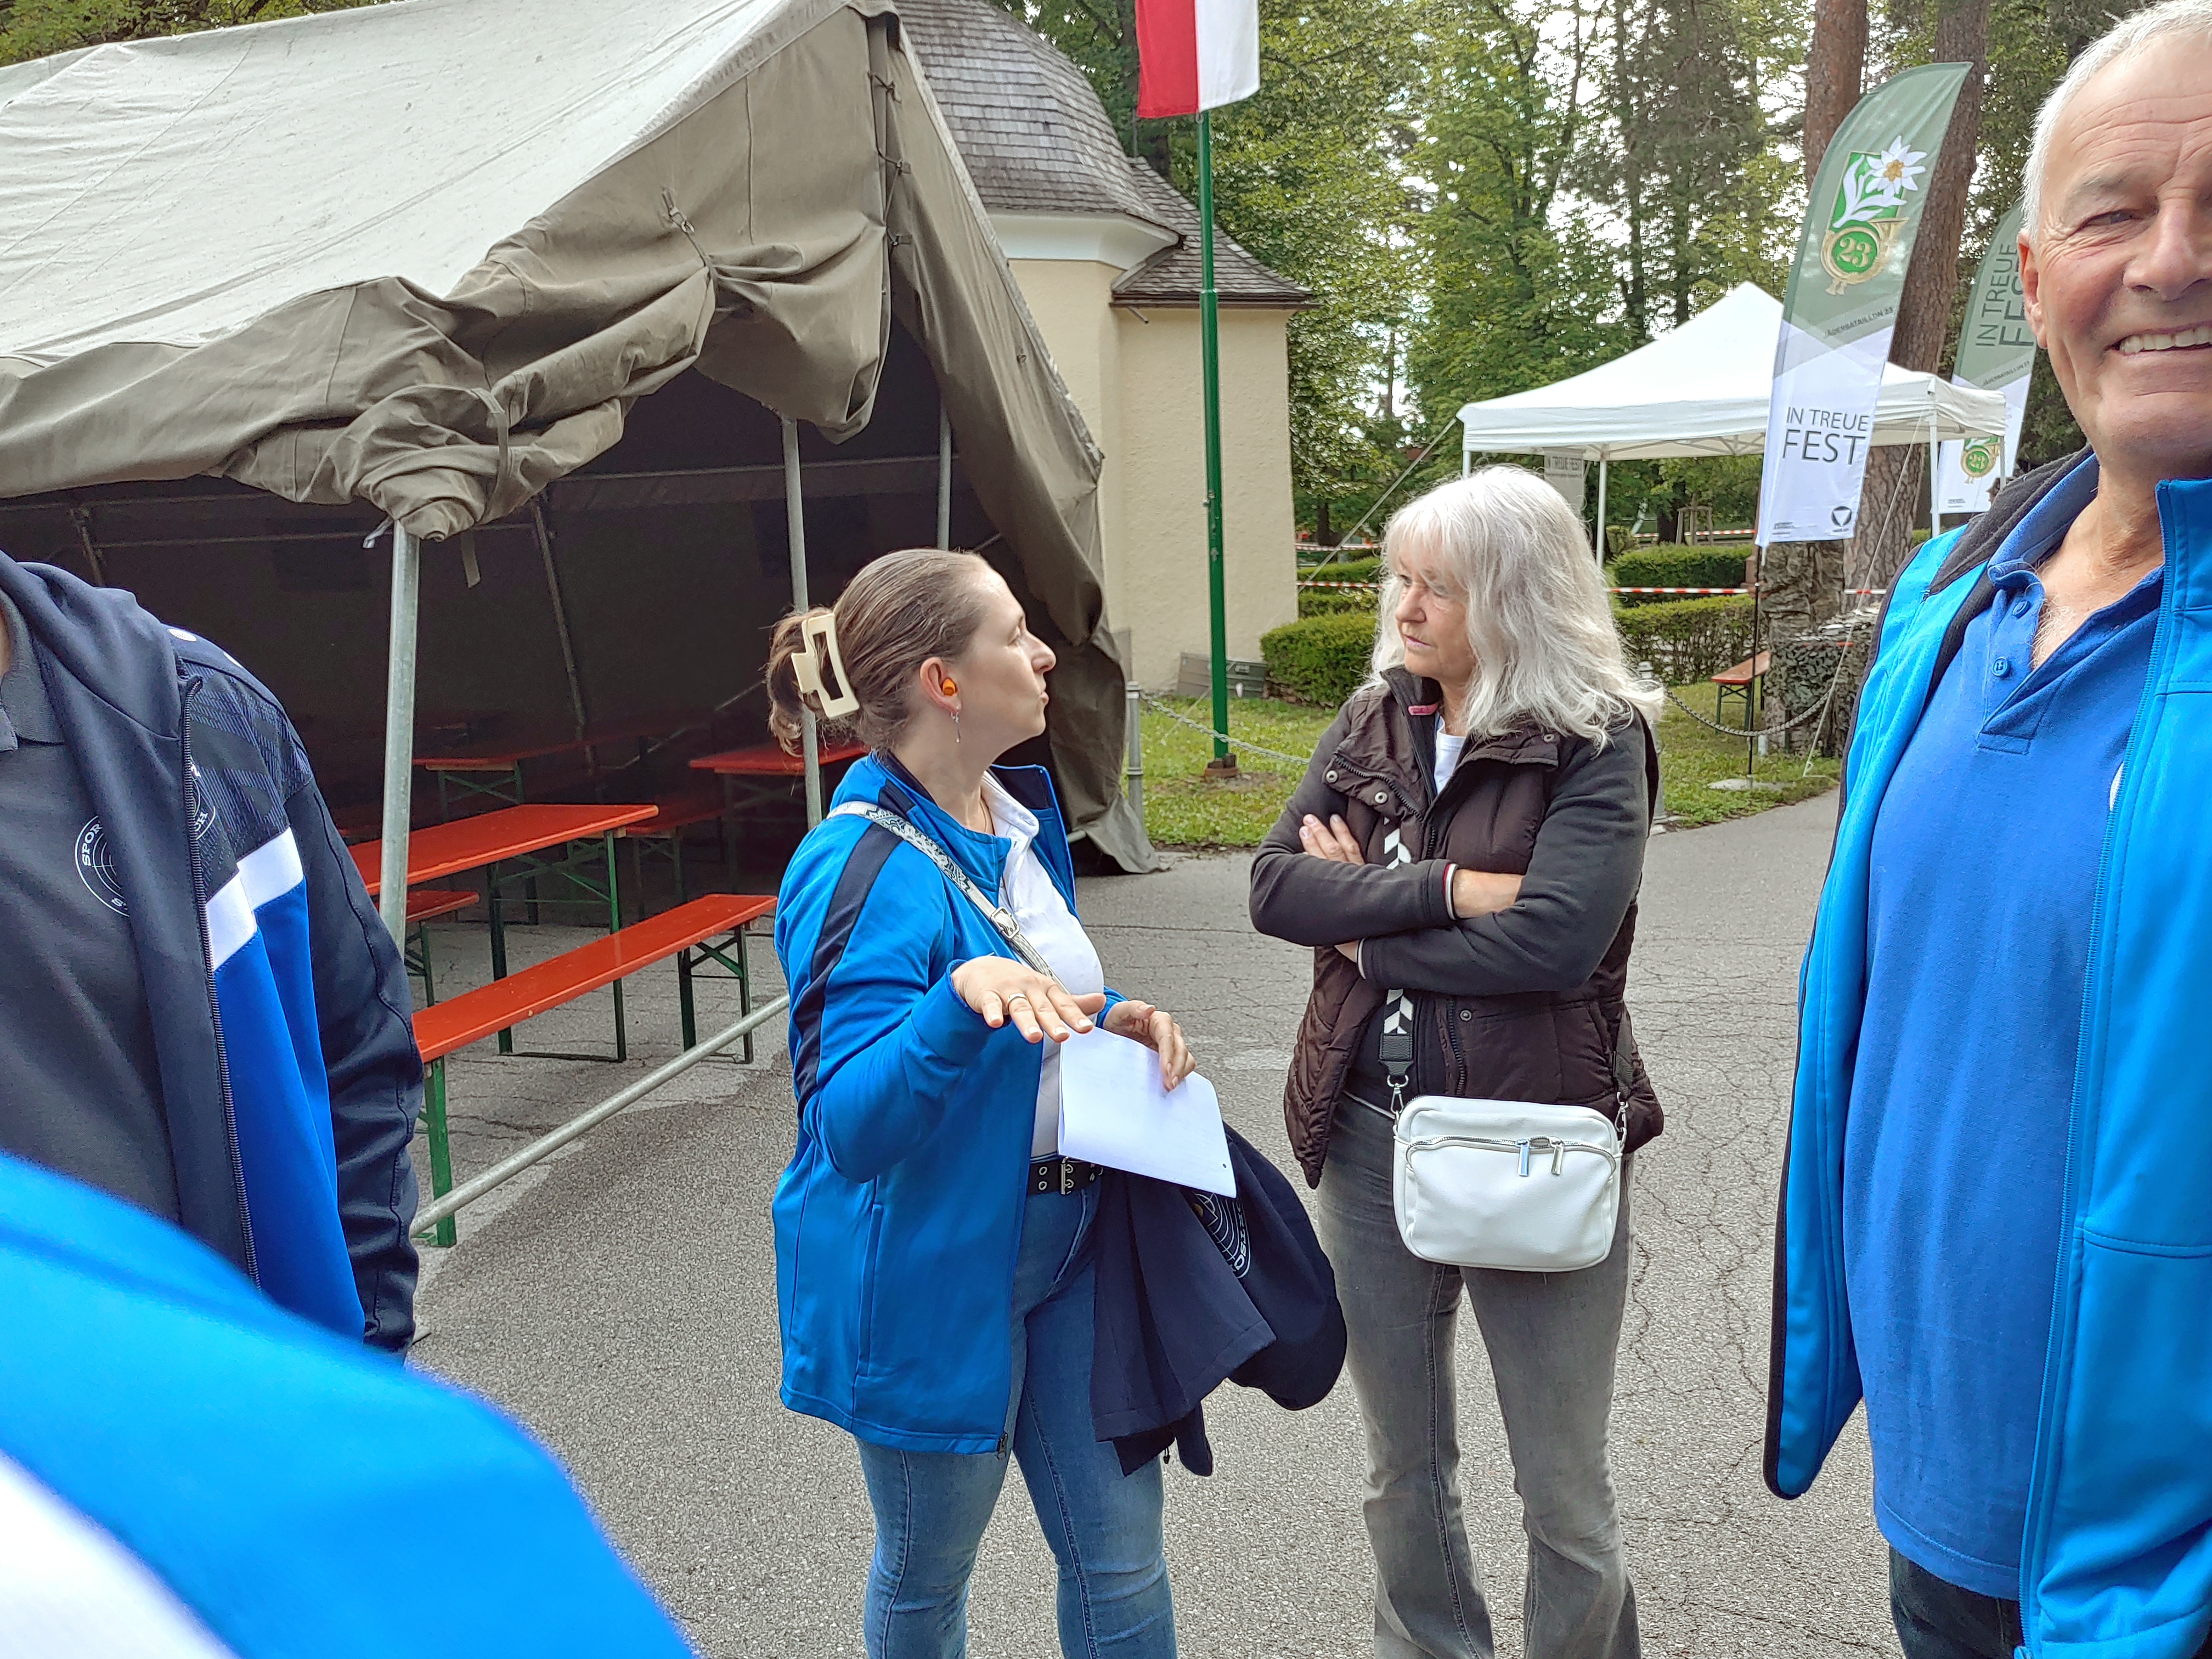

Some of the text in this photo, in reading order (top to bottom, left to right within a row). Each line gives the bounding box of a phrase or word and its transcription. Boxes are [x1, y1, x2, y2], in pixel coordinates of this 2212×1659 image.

[1837, 238, 1872, 267] 23
[1976, 244, 2017, 346] IN TREUE
[1786, 407, 1870, 431] IN TREUE
[1782, 428, 1866, 465] FEST
[82, 822, 103, 866] SPOR
